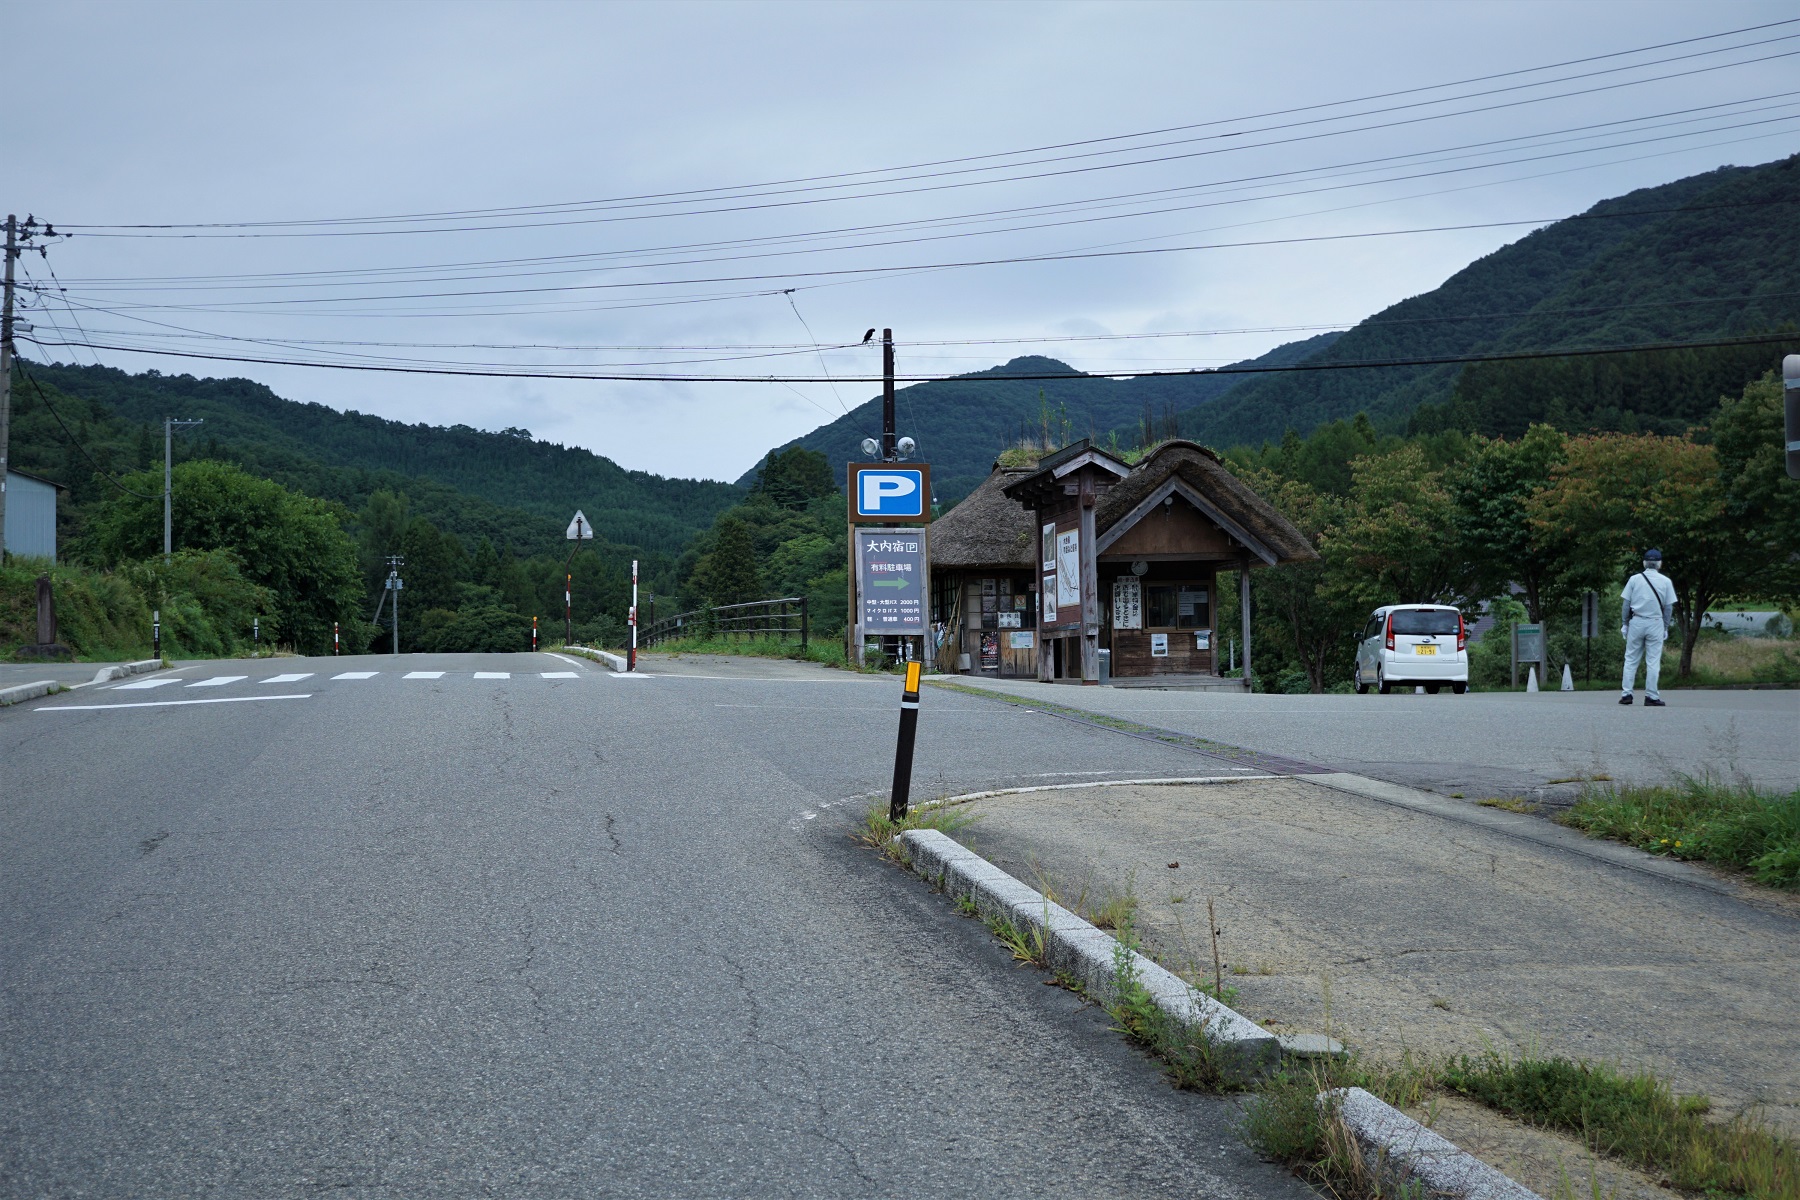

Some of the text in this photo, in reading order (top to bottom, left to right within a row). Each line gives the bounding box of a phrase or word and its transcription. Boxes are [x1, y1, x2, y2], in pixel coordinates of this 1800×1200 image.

[864, 475, 916, 510] P
[870, 563, 912, 572] 有料駐車場
